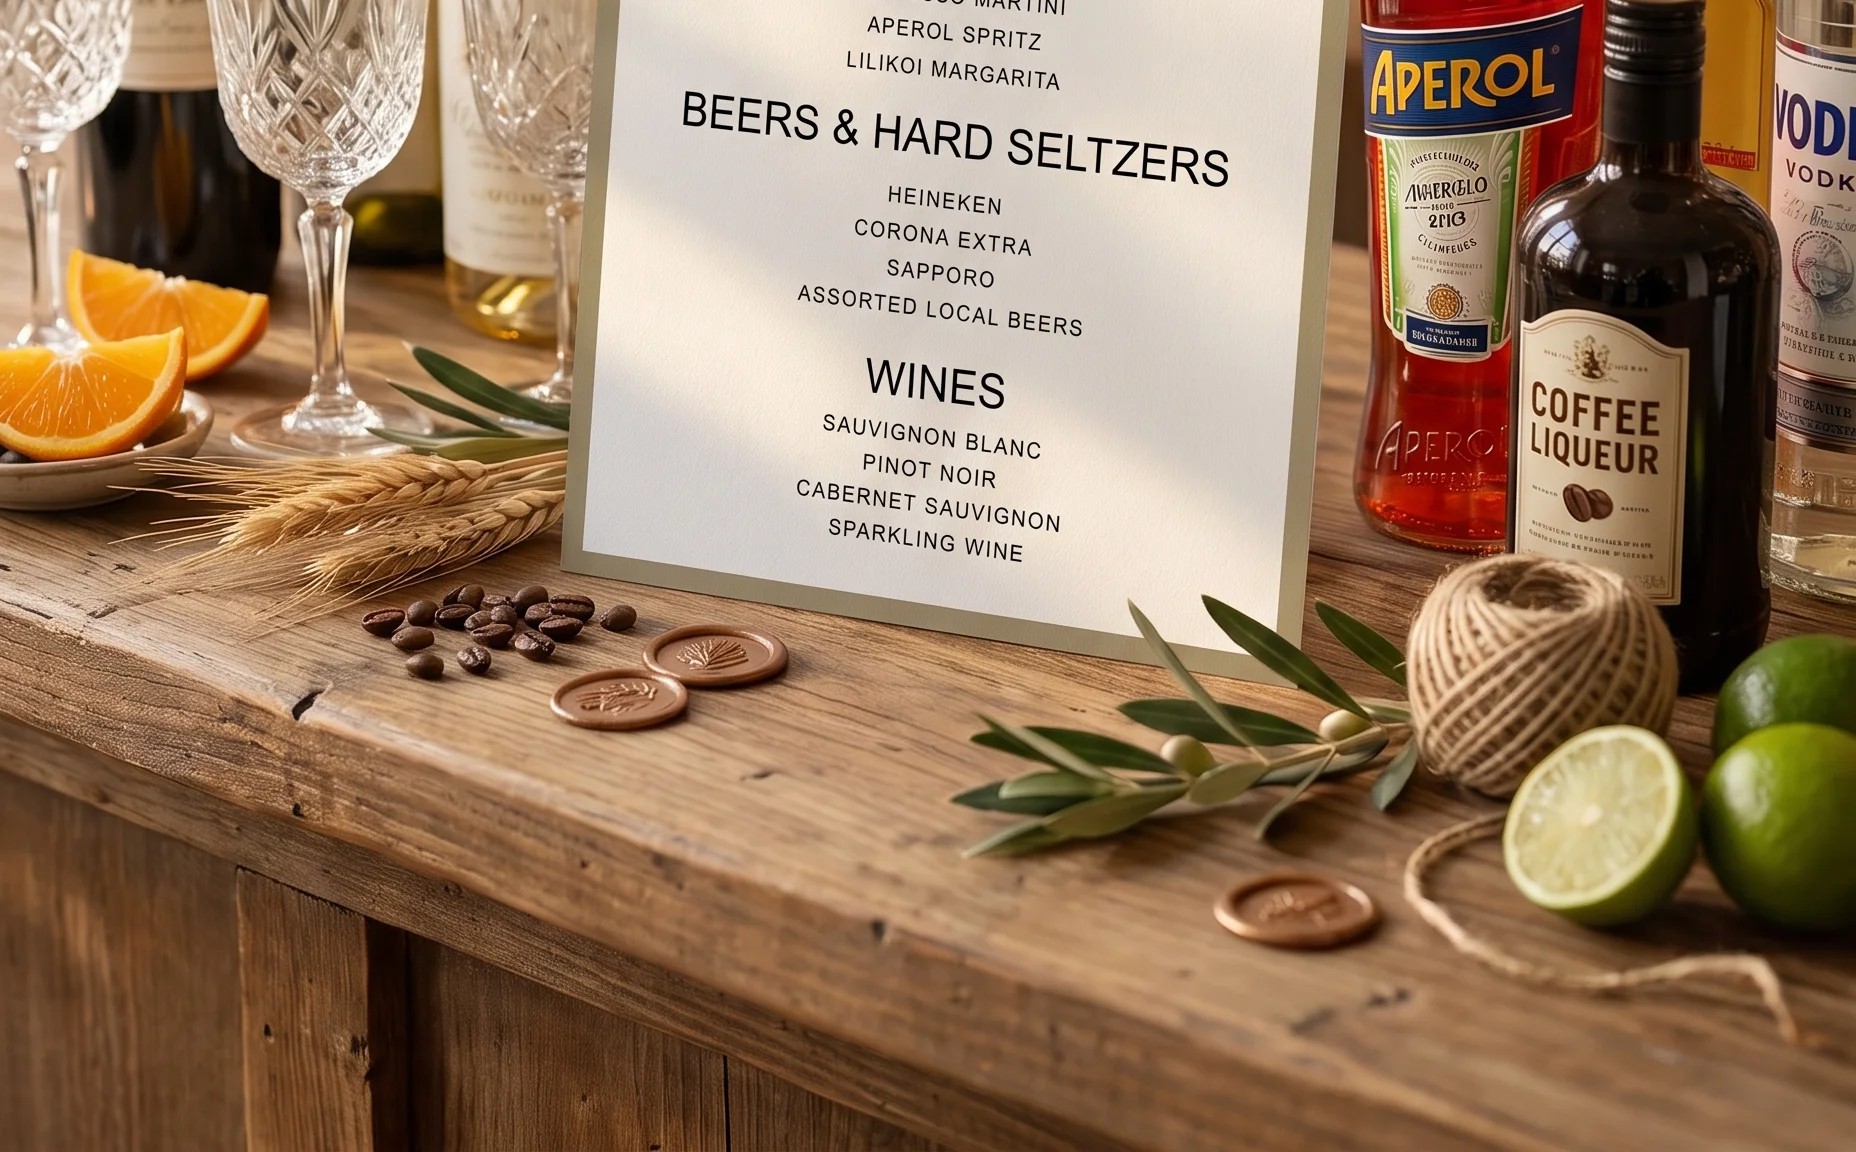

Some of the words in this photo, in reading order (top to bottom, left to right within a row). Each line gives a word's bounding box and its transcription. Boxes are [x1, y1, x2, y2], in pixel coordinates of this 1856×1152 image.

[867, 15, 954, 42] APEROL
[962, 25, 1042, 51] SPRITZ
[846, 50, 922, 76] LILIKOI
[931, 60, 1060, 91] MARGARITA
[1369, 47, 1555, 116] APEROL
[682, 90, 819, 141] BEERS
[833, 108, 859, 146] &
[874, 113, 993, 161] HARD
[1007, 128, 1229, 188] SELTZERS
[1775, 82, 1856, 161] VOD
[888, 185, 1002, 216] HEINEKEN
[854, 218, 949, 247] CORONA
[958, 230, 1032, 257] EXTRA
[887, 258, 995, 289] SAPPORO
[797, 284, 917, 315] ASSORTED
[926, 300, 999, 327] LOCAL
[1008, 310, 1082, 337] BEERS
[866, 357, 1005, 410] WINES
[1531, 380, 1661, 438] COFFEE
[822, 413, 956, 448] SAUVIGNON
[965, 432, 1041, 460] BLANC
[1530, 421, 1660, 476] LIQUEUR
[863, 453, 932, 479] PINOT
[940, 464, 996, 489] NOIR
[796, 479, 917, 511] CABERNET
[924, 497, 1060, 533] SAUVIGNON
[828, 518, 955, 553] SPARKLING
[964, 537, 1023, 563] WINE
